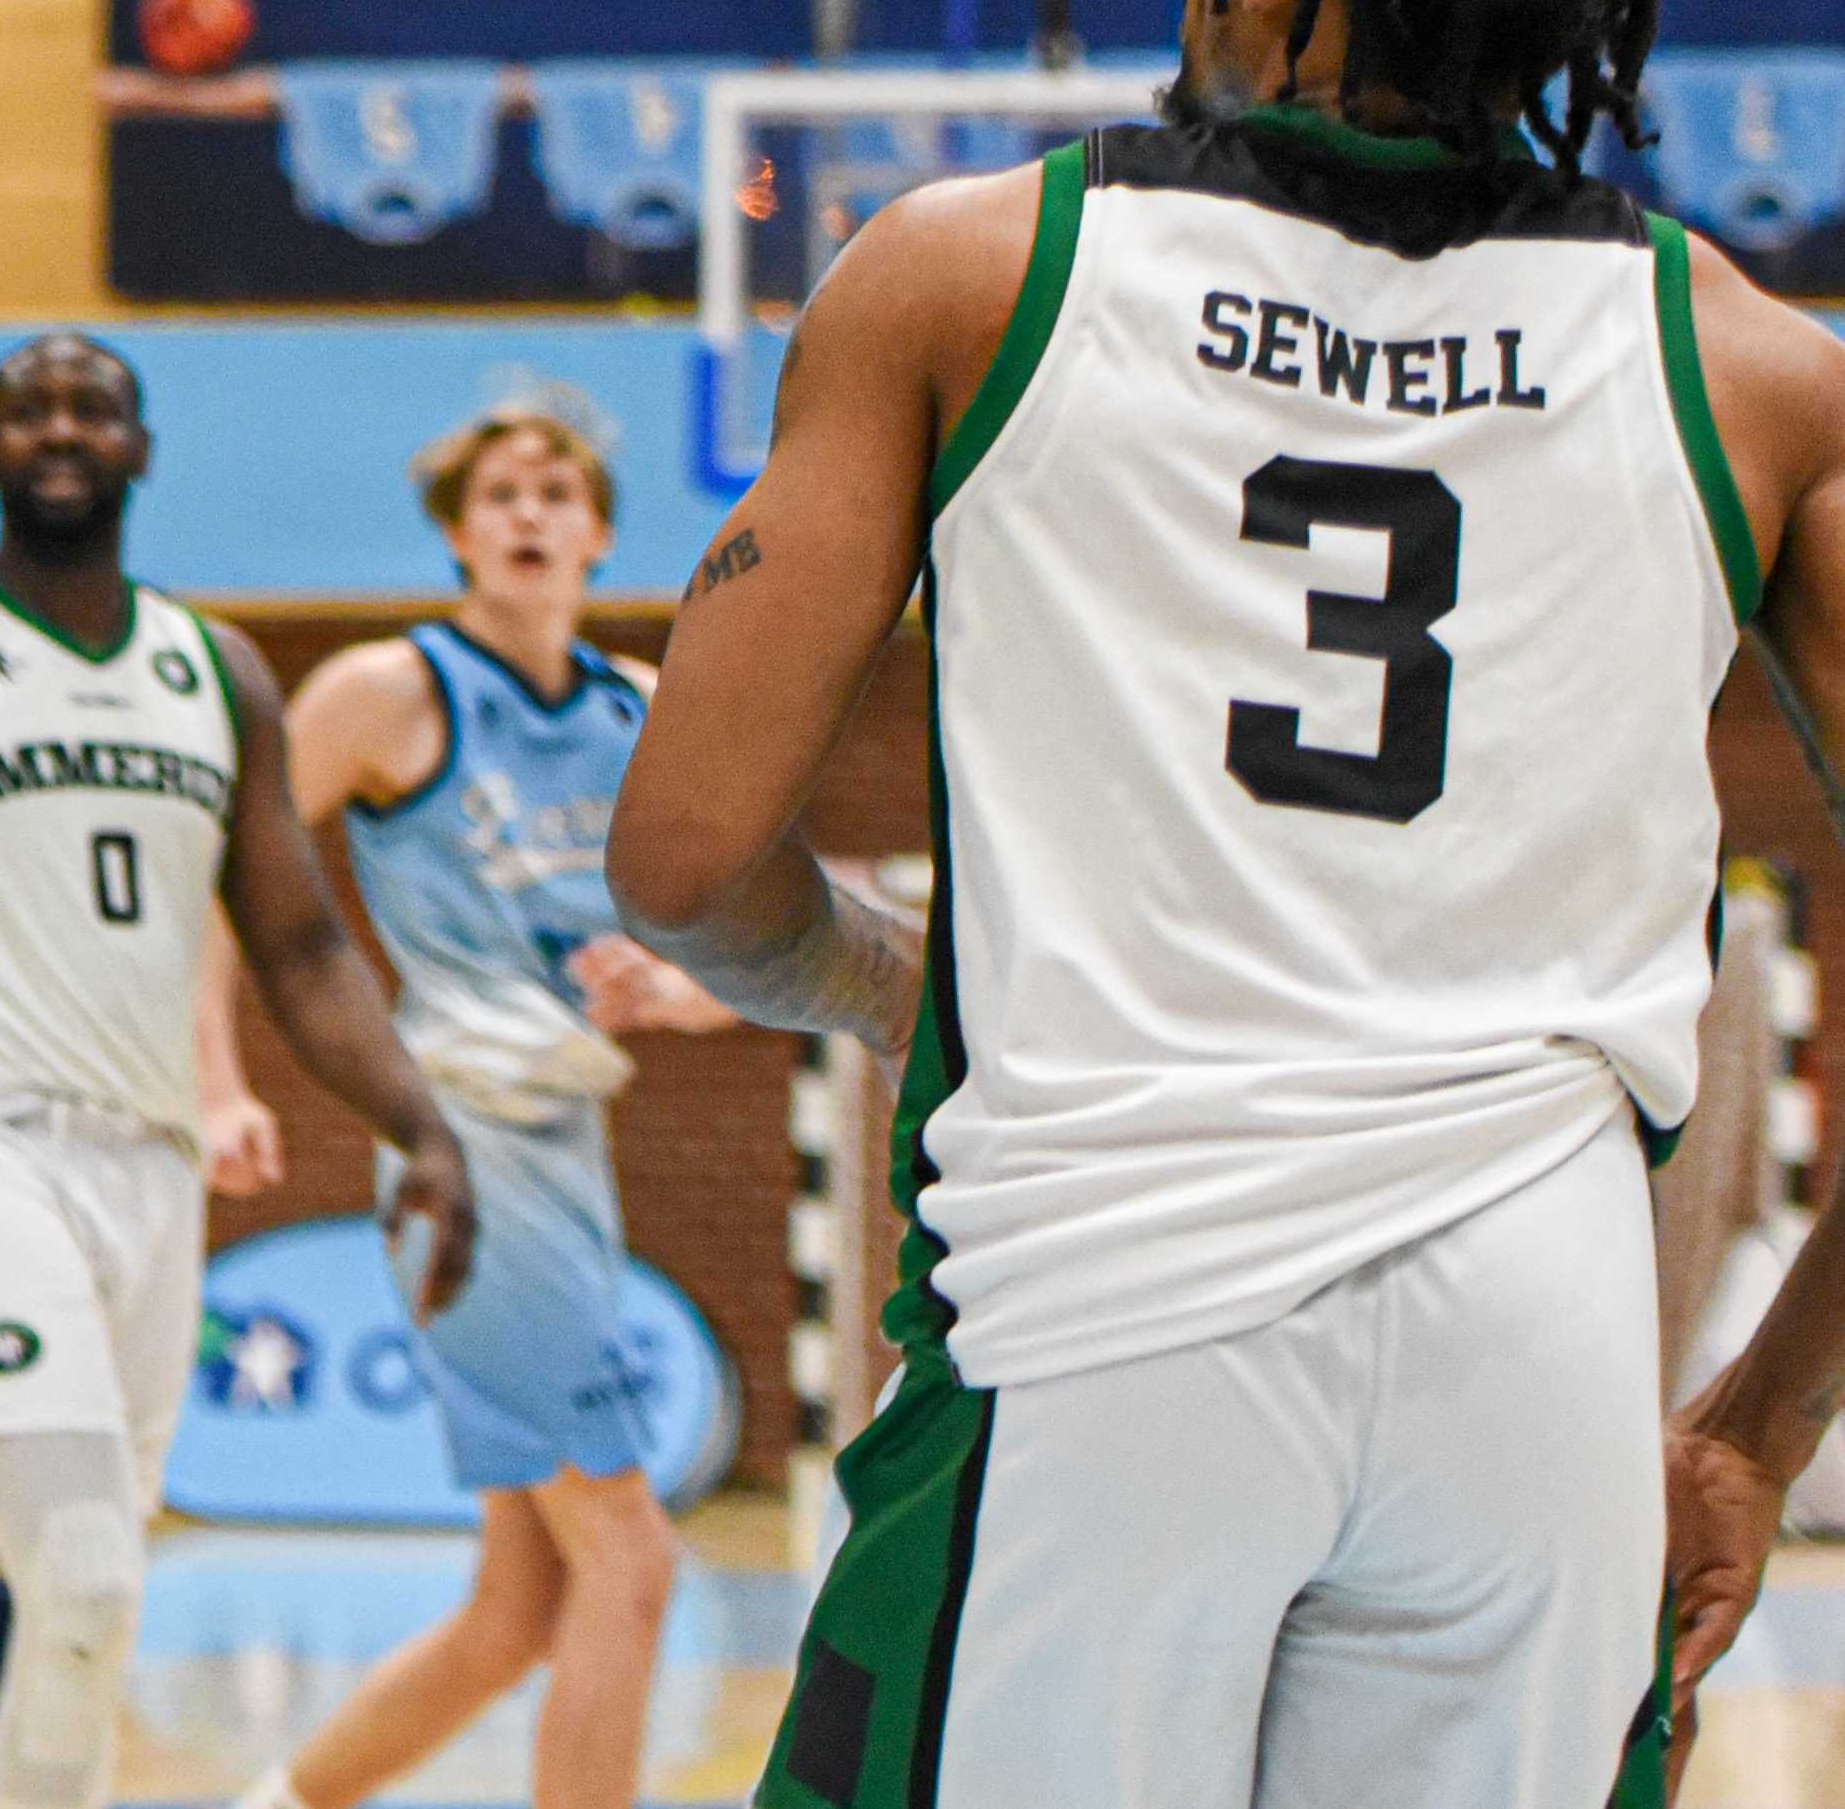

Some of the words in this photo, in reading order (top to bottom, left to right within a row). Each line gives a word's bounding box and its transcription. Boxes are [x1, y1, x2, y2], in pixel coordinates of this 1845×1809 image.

[1197, 289, 1546, 417] SEWELL
[1225, 453, 1463, 825] 3
[90, 829, 141, 923] 0
